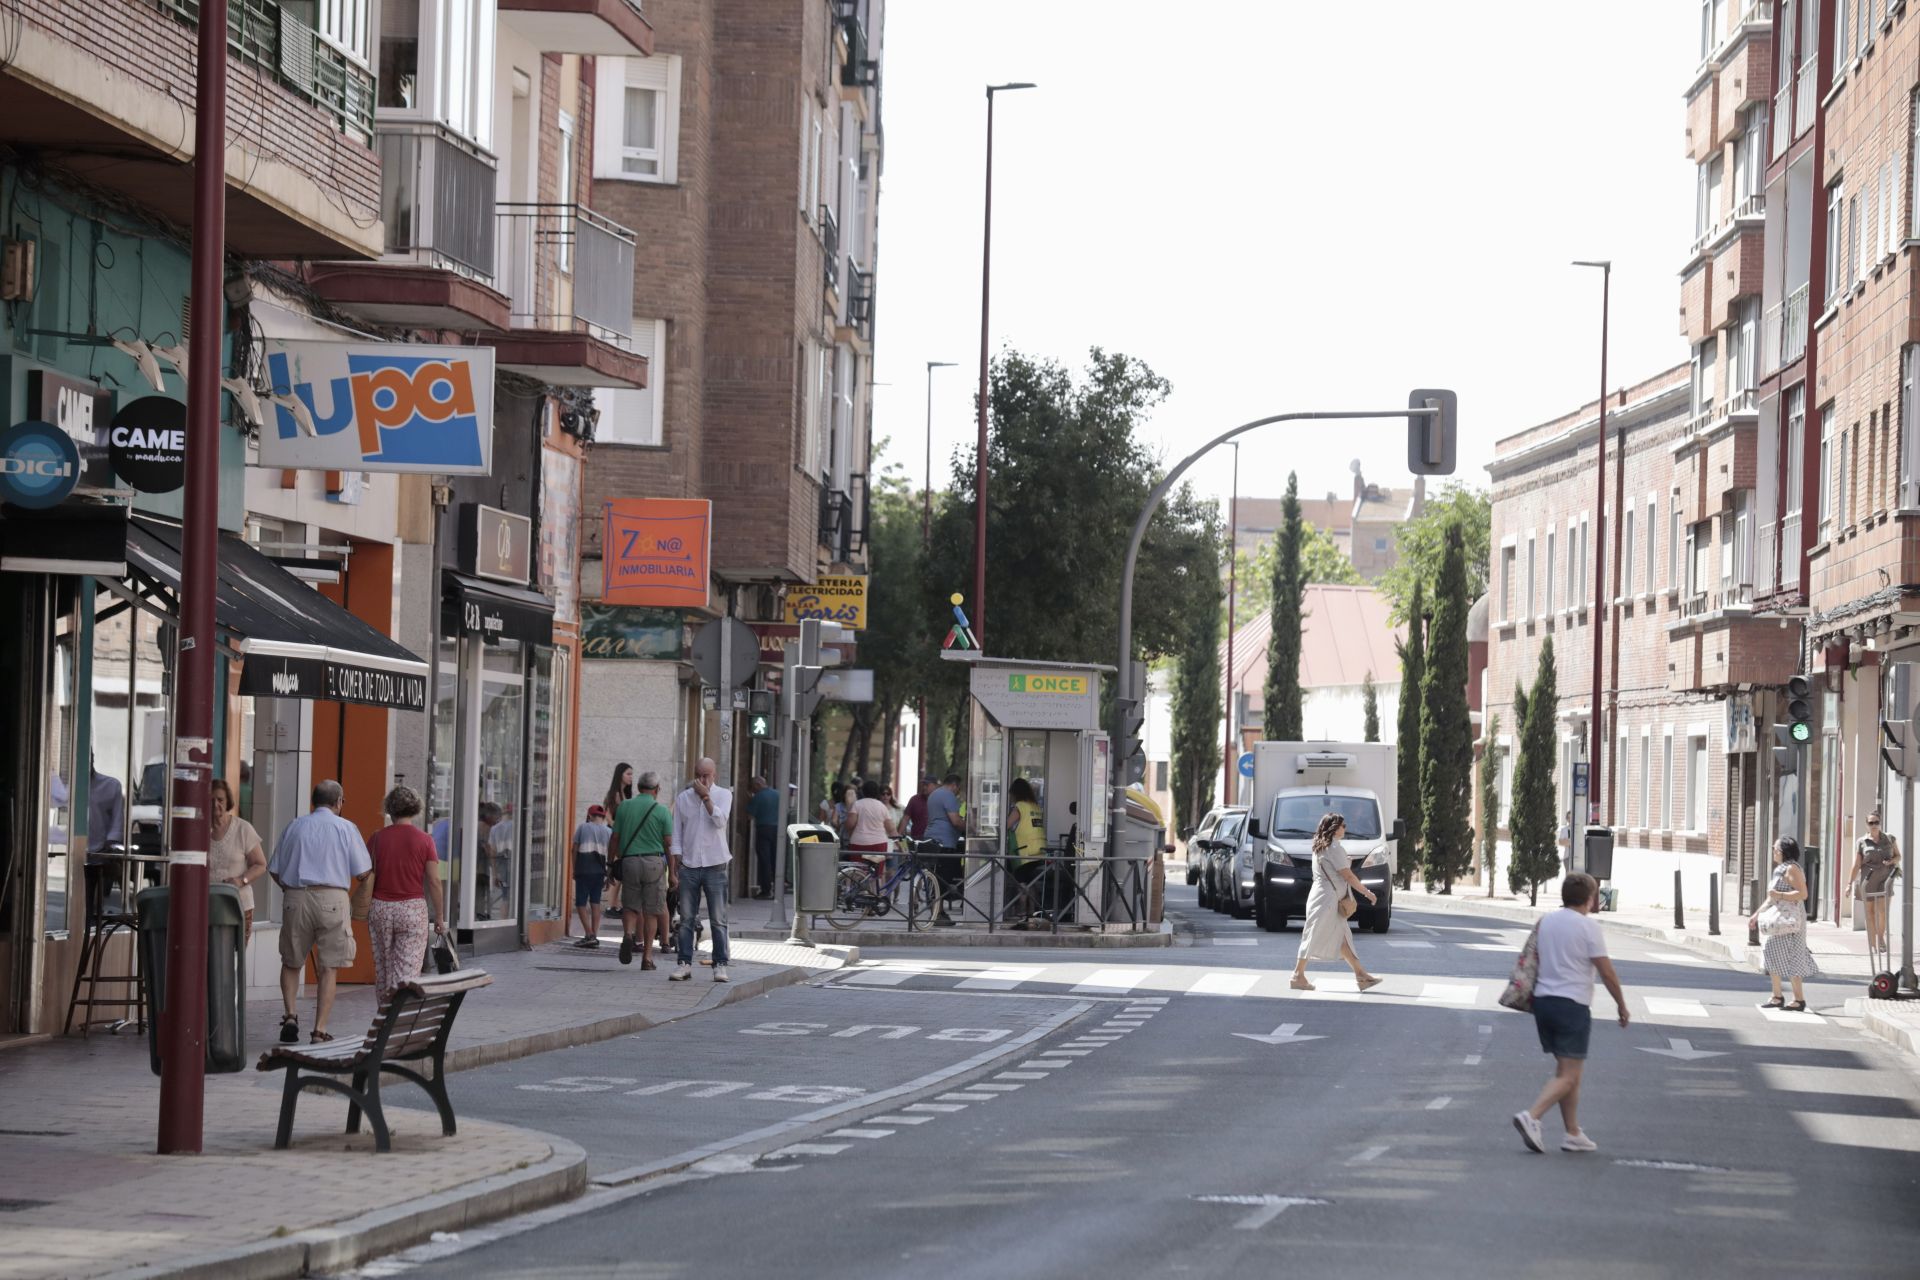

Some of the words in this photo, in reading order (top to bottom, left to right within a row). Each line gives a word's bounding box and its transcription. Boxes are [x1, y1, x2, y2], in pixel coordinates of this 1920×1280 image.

[268, 352, 476, 454] lupa
[57, 386, 96, 445] CAMEL
[111, 427, 185, 450] CAME
[0, 458, 72, 477] DIGI
[618, 564, 696, 578] INMOBILIARIA
[787, 586, 863, 596] ELECTRICIDAD
[817, 579, 863, 587] ETERIA
[328, 666, 336, 696] EL
[339, 668, 364, 699] COMER
[365, 672, 373, 700] DE
[375, 673, 394, 703] TODA
[396, 677, 404, 704] LA
[406, 678, 423, 706] VIDA
[1031, 678, 1080, 691] ONCE
[736, 1021, 1013, 1043] BUS
[514, 1076, 867, 1104] BUS
